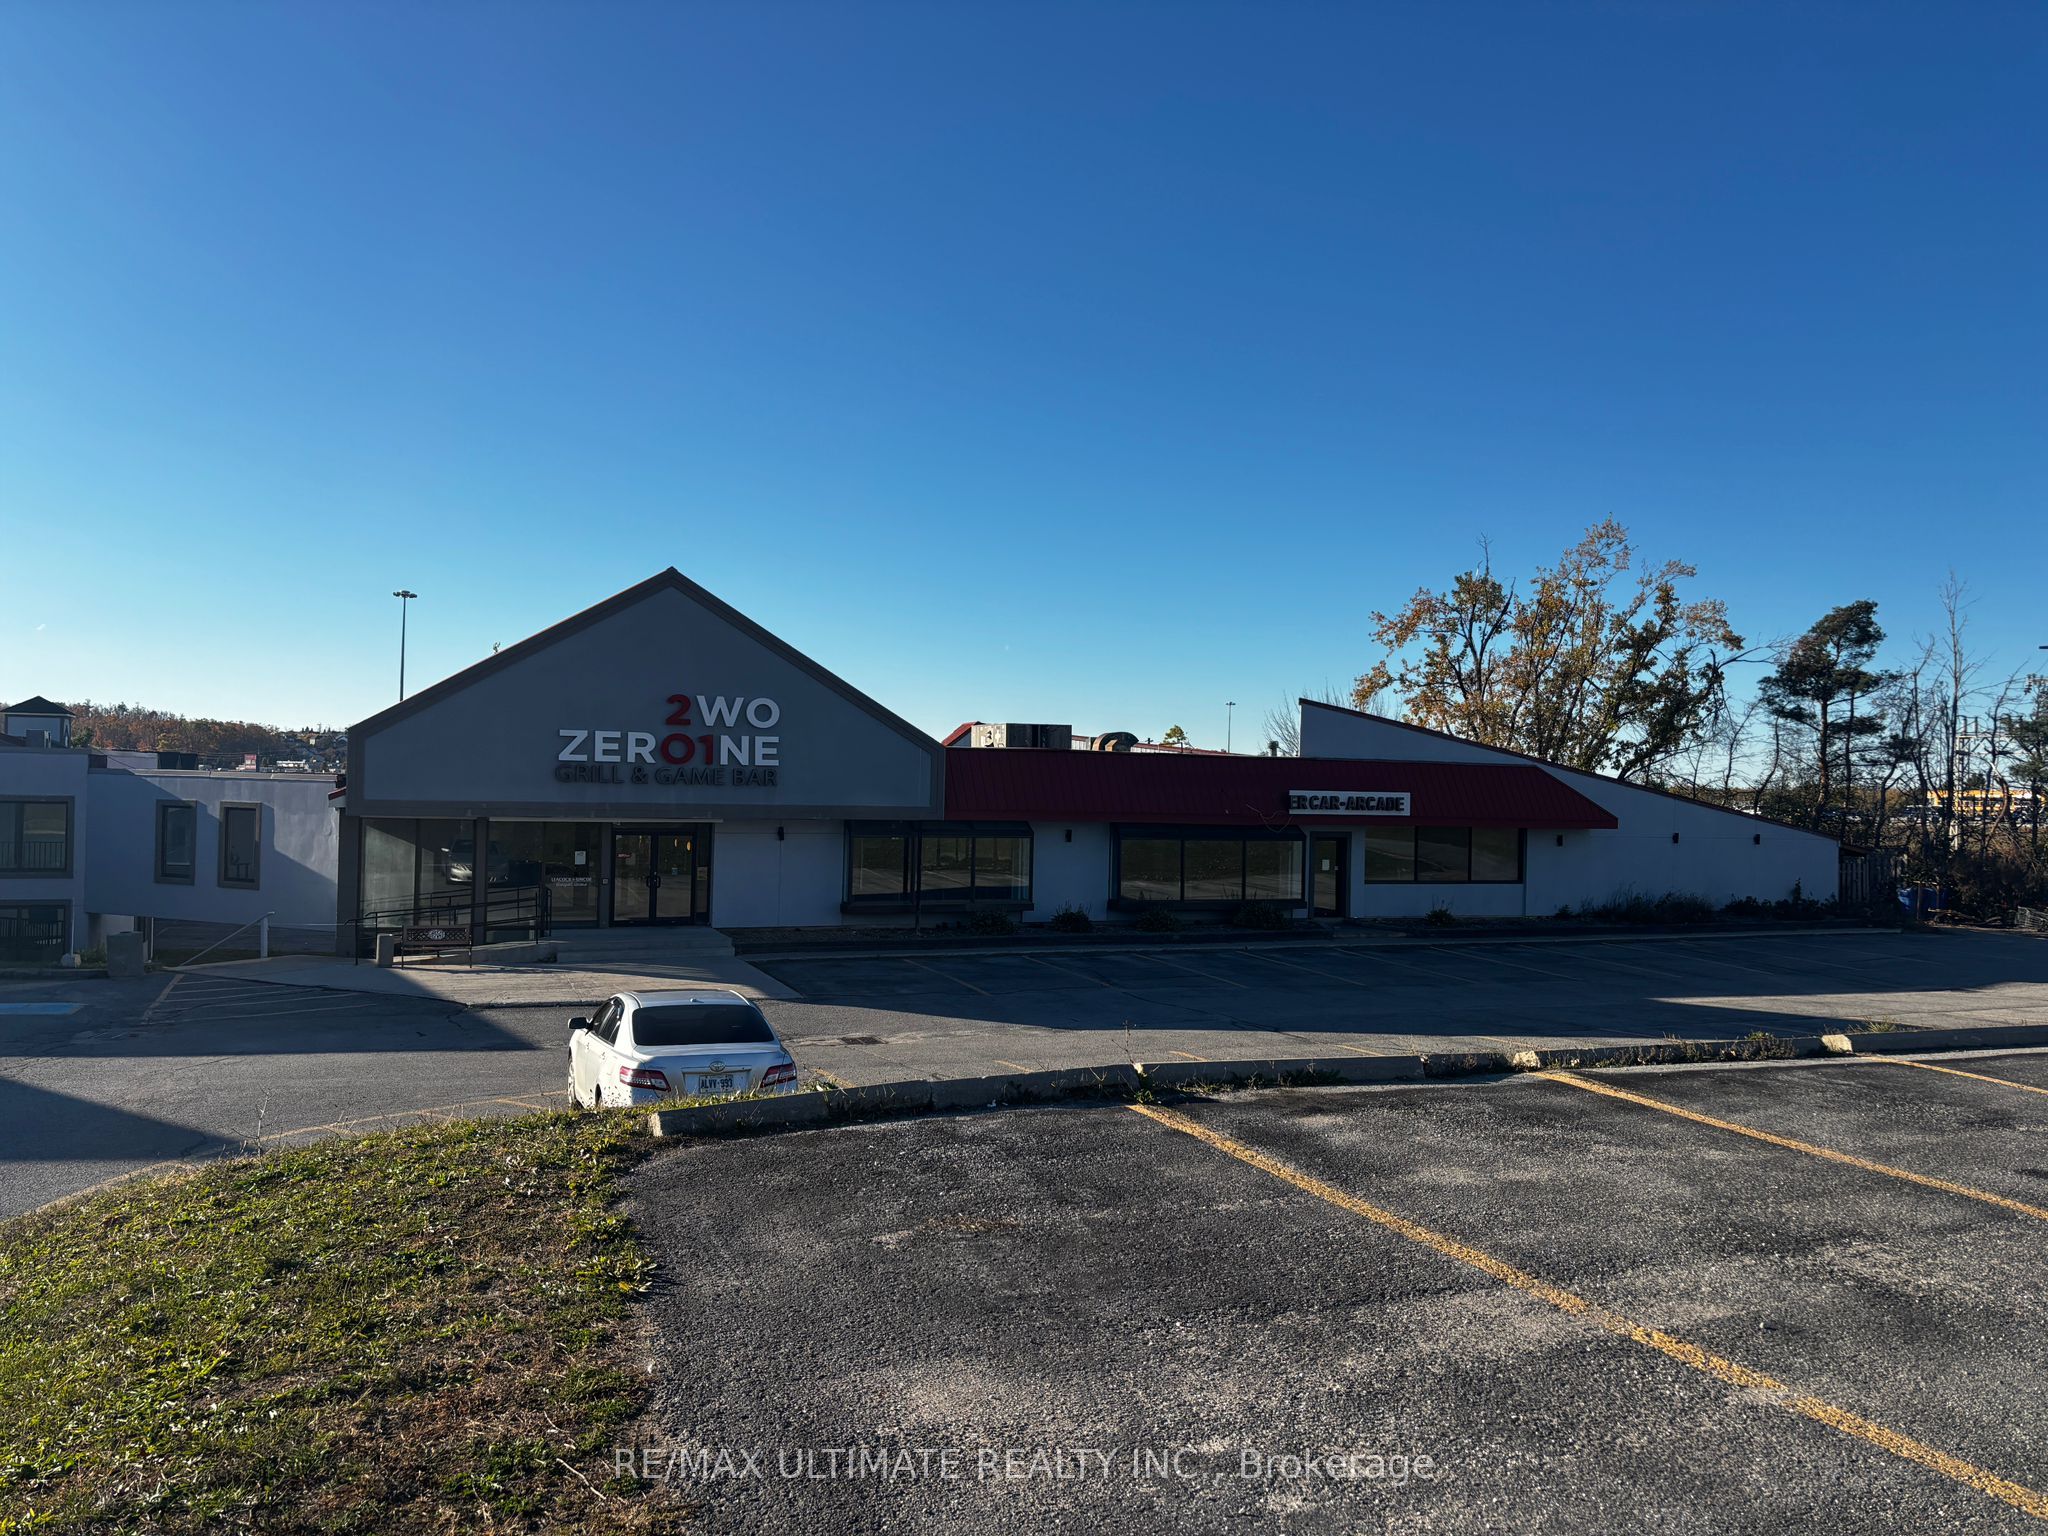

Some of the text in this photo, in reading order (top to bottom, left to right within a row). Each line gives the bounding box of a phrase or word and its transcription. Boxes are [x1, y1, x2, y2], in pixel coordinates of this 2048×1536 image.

[665, 694, 780, 729] 2WO
[555, 764, 778, 787] GRILL & GAME BAR
